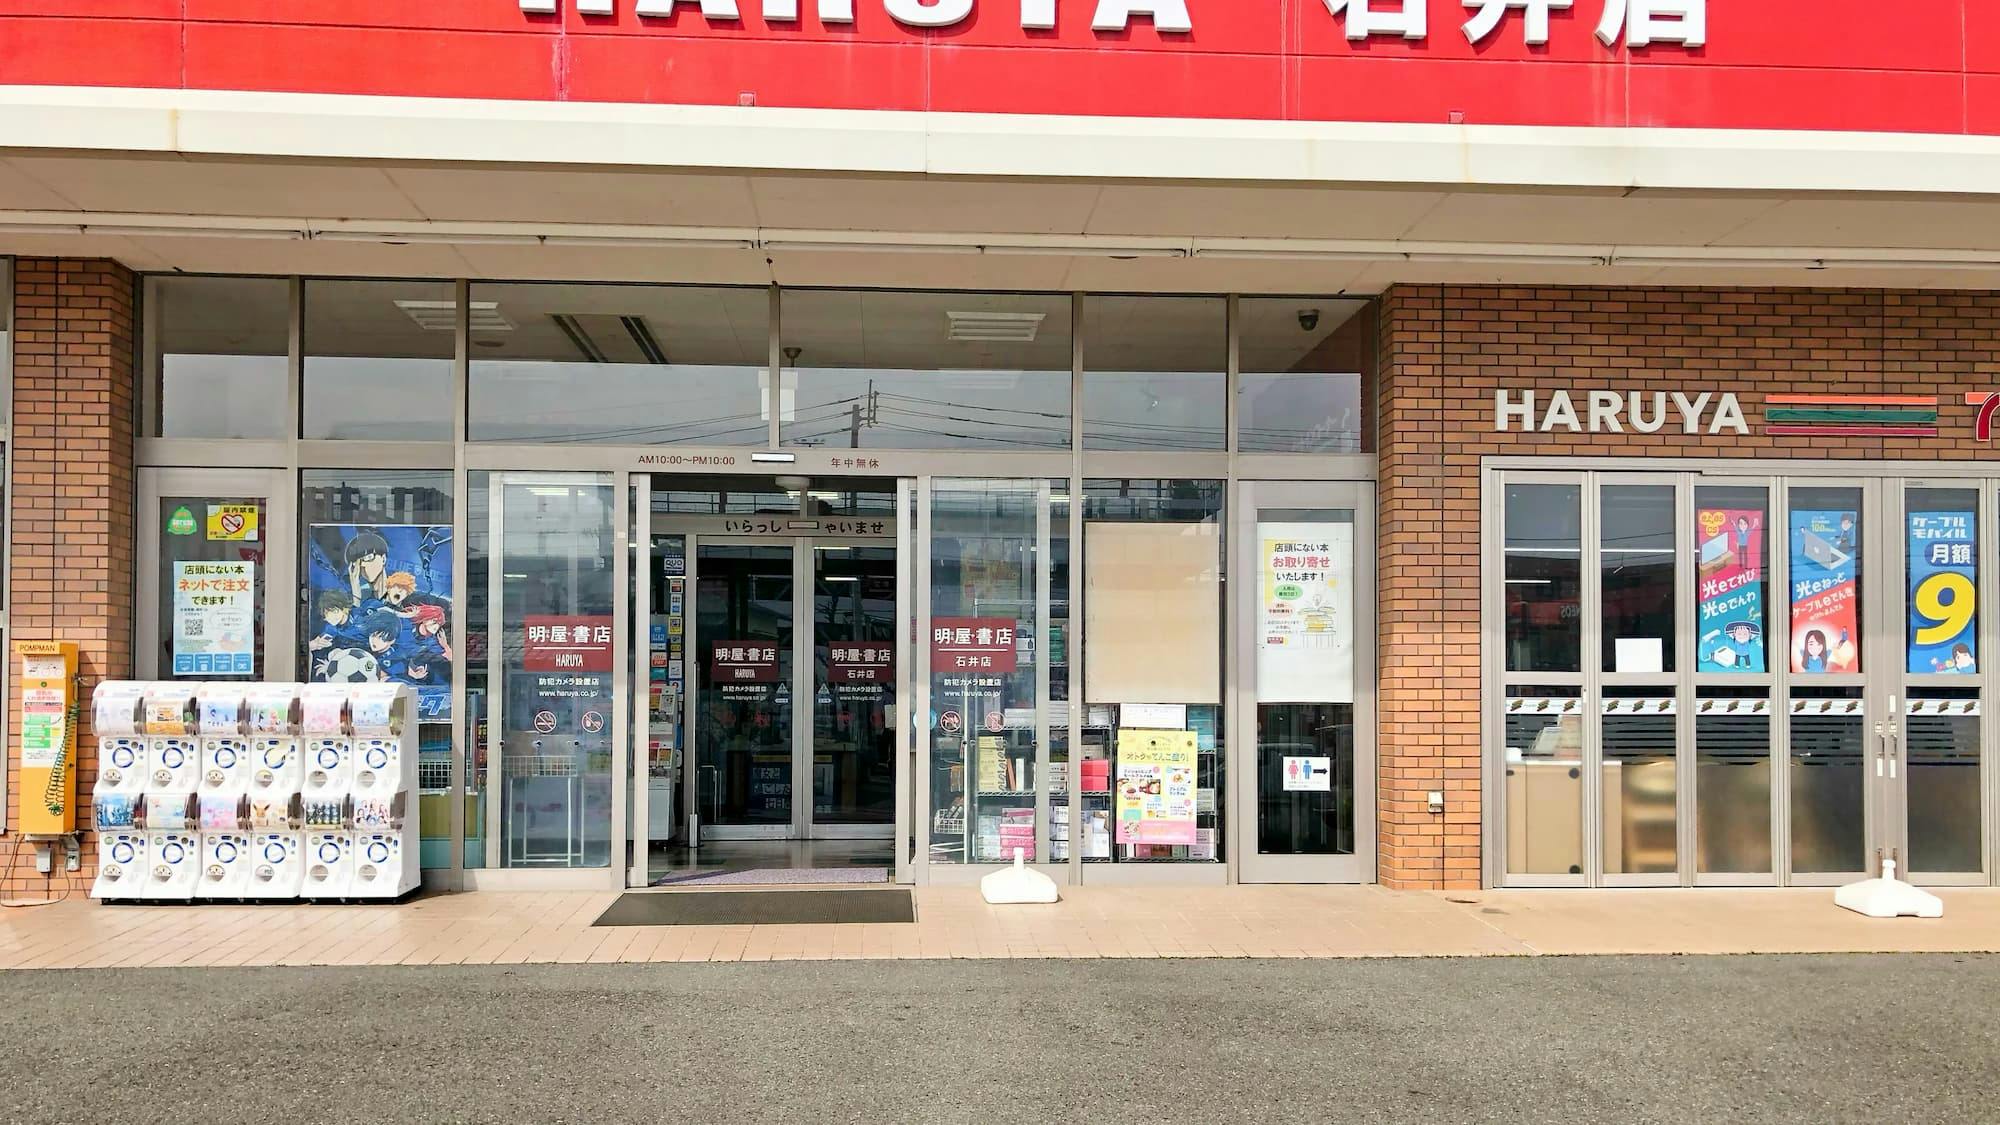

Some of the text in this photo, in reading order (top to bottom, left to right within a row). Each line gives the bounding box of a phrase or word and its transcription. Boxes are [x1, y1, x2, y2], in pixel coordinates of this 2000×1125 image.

[1495, 388, 1750, 434] HARUYA
[831, 457, 880, 469] 年中無休
[1913, 517, 1966, 527] ケーブル
[1913, 528, 1967, 538] モバイル
[1274, 543, 1329, 552] 店頭にない本
[1931, 543, 1971, 564] 月額
[1272, 556, 1330, 568] お取り寄せ
[184, 565, 244, 574] 店頭にない本
[179, 579, 249, 591] ネットで注文
[556, 655, 583, 667] HARUYA
[956, 656, 991, 667] 石井店
[848, 670, 874, 679] 石井店
